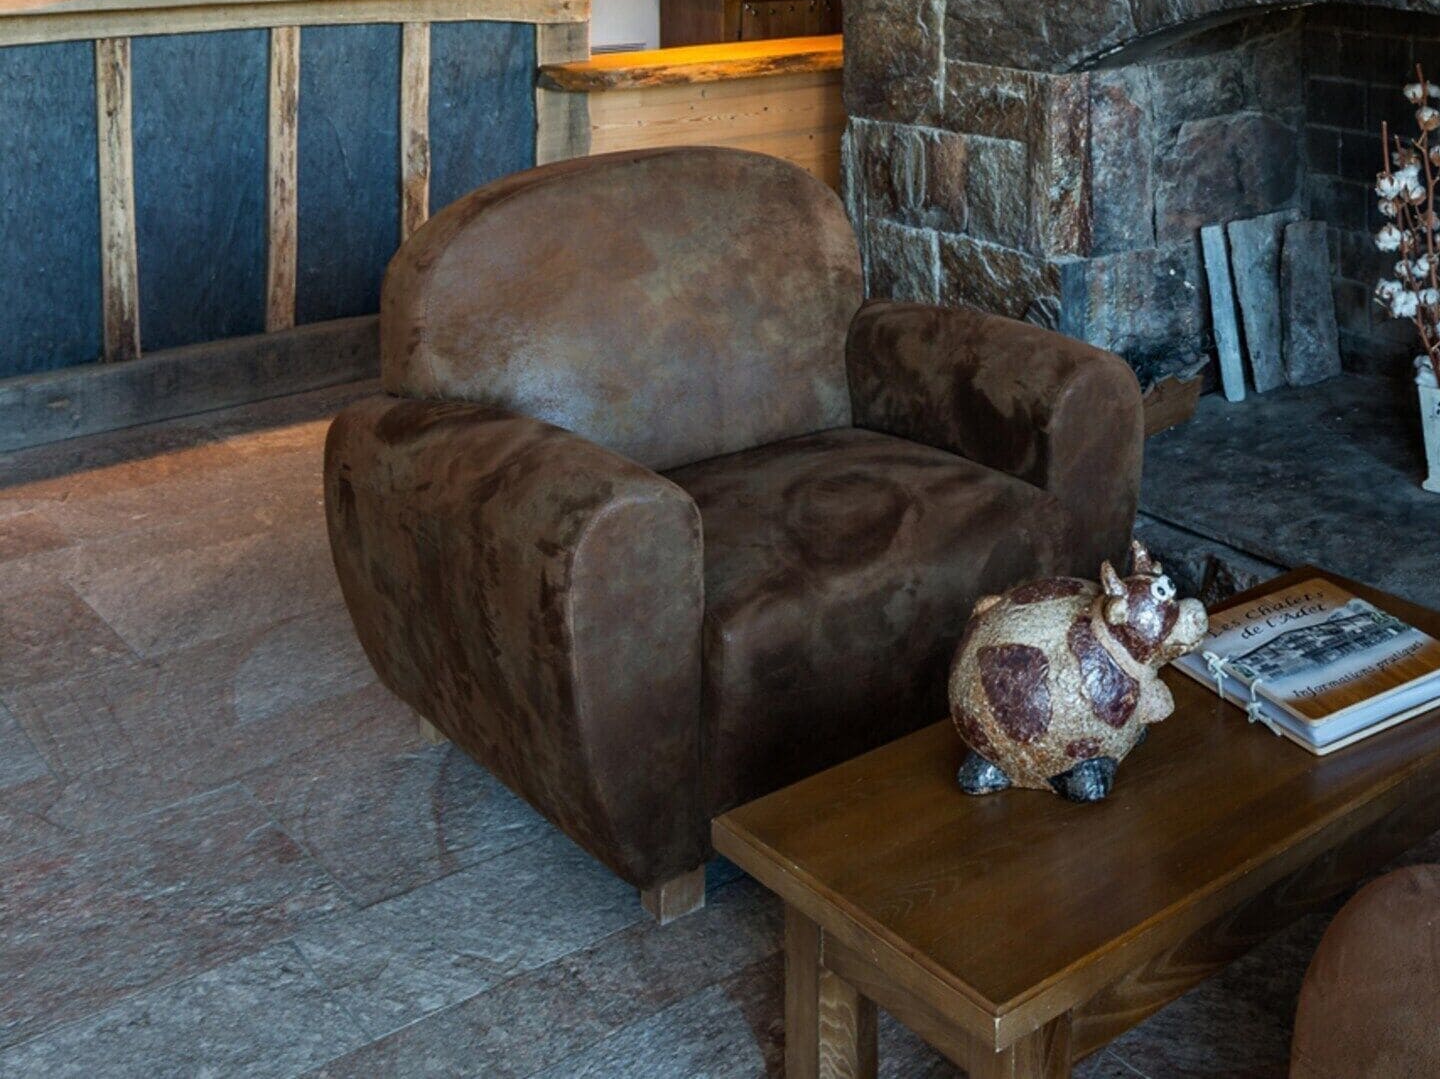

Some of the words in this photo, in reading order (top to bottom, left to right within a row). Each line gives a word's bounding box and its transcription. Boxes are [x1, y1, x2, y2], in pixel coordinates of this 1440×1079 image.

[1208, 619, 1241, 638] Les
[1244, 591, 1325, 620] Chalets
[1241, 624, 1264, 640] de
[1292, 664, 1377, 699] Informations
[1376, 640, 1425, 672] pratiques
